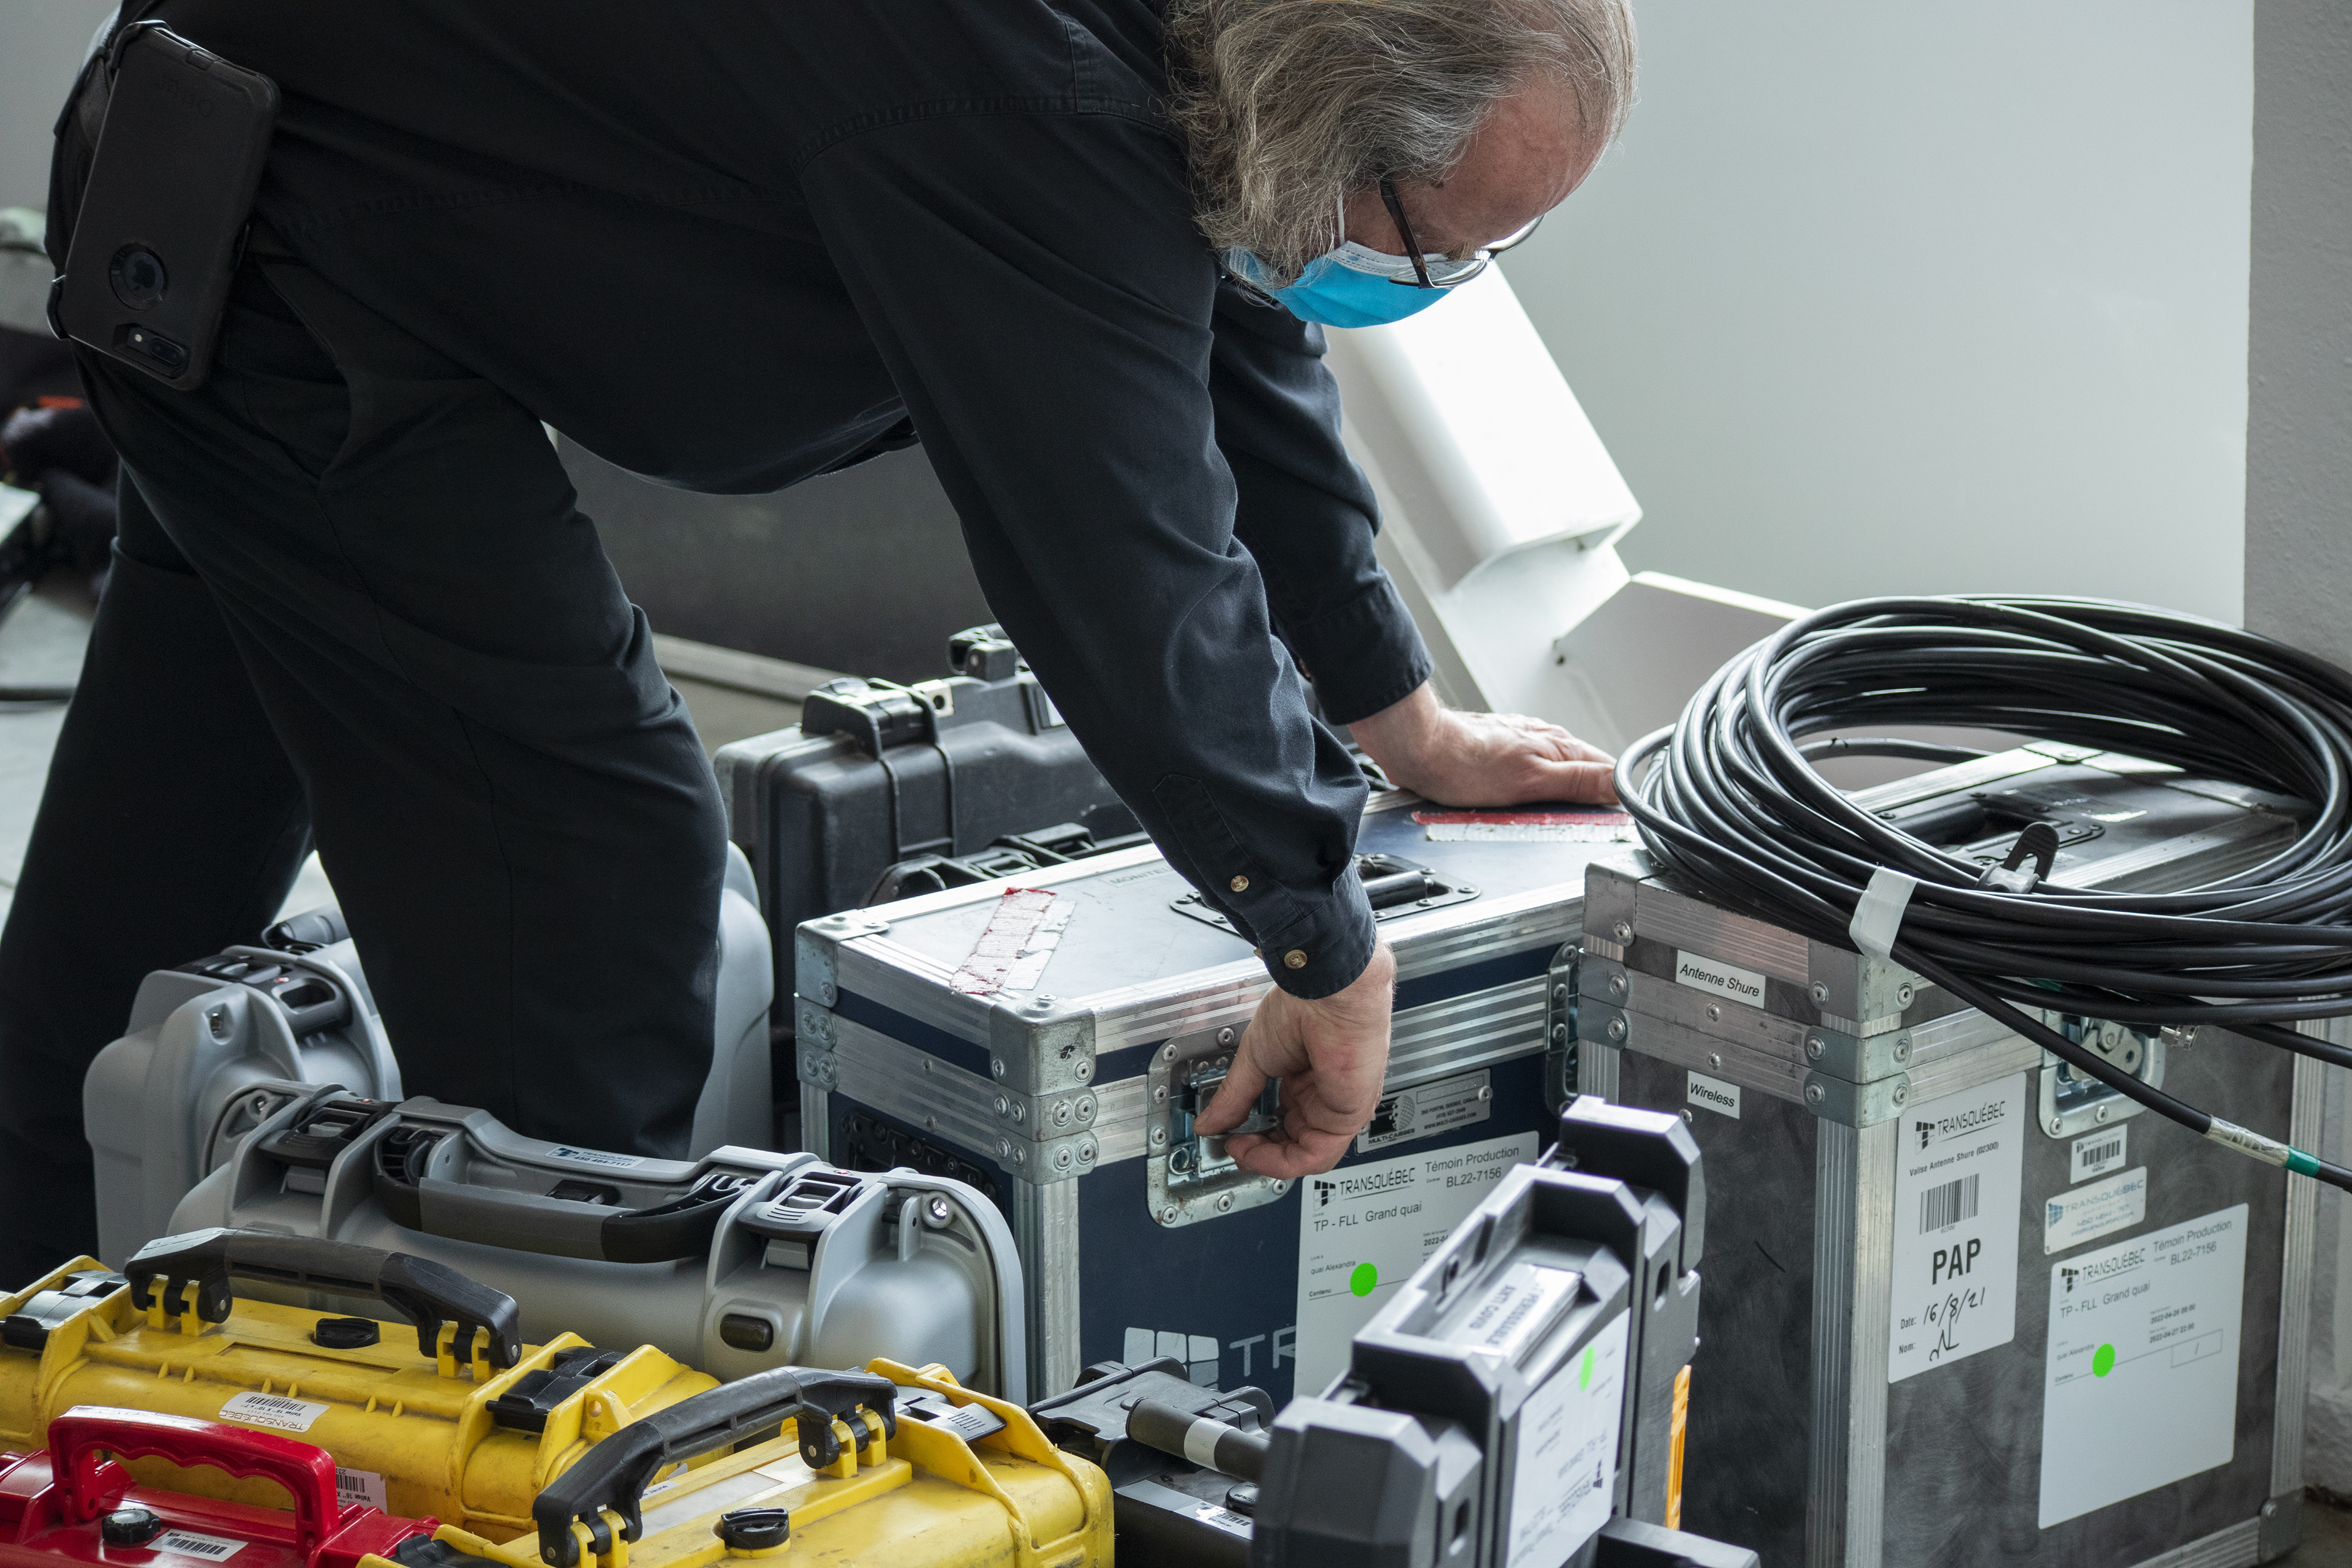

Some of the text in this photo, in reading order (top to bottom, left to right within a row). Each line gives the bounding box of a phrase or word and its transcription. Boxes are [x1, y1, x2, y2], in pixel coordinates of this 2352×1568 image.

[1680, 963, 1760, 997] Antenne Shure
[1690, 1082, 1735, 1107] Wireless
[1937, 1101, 2006, 1136] TRANSQUÉBEC
[1425, 1147, 1520, 1173] Témoin Production
[1909, 1141, 1999, 1177] Valise Antenne Shure (02300)
[1340, 1167, 1415, 1196] TRANSQUÉBEC
[1446, 1167, 1502, 1188] BL22-7156
[1314, 1219, 1329, 1232] TP
[1339, 1214, 1359, 1227] FLL
[1365, 1205, 1397, 1222] Grand
[1400, 1200, 1422, 1217] quai
[2154, 1219, 2233, 1253] Témoin Production
[1932, 1237, 1981, 1286] PAP
[2082, 1248, 2146, 1281] TRANSQUÉBEC
[2171, 1241, 2217, 1266] BL22-7156
[2060, 1305, 2073, 1319] TP
[2081, 1298, 2098, 1314] FLL
[2103, 1287, 2130, 1305] Grand
[2132, 1280, 2150, 1298] quai
[1901, 1317, 1917, 1329] Date:
[1899, 1342, 1916, 1355] Nom:
[219, 1409, 303, 1430] TRANSQUÉBEC
[354, 1494, 371, 1502] Valise
